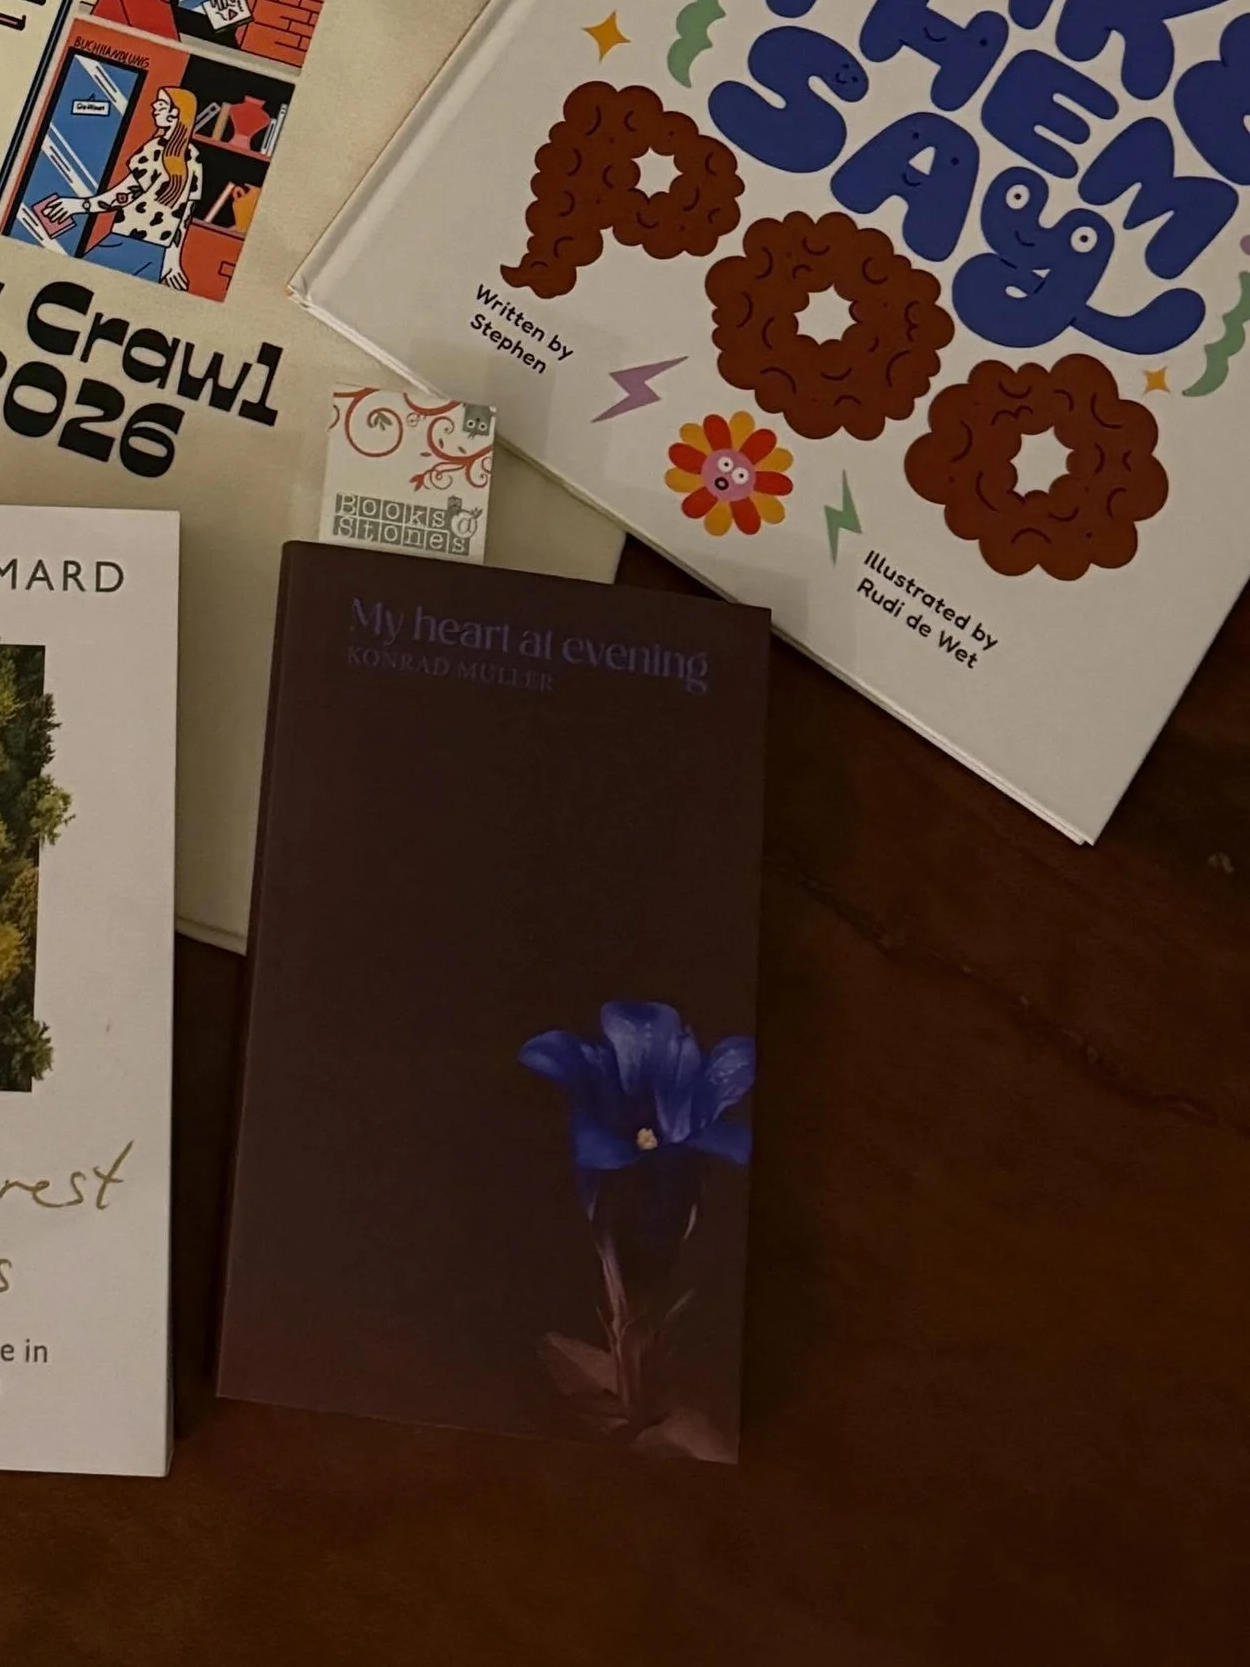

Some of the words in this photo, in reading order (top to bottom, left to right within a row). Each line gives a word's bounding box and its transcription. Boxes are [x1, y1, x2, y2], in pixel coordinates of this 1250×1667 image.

[24, 280, 285, 428] Crawl
[470, 313, 546, 374] Stephen
[476, 284, 545, 342] Written
[547, 334, 574, 361] by
[333, 514, 469, 556] Stones
[857, 577, 905, 617] Rudi
[906, 615, 932, 637] de
[938, 630, 977, 669] Wet
[864, 550, 971, 630] Illustrated
[971, 622, 998, 651] by
[346, 646, 448, 677] KONRAD
[348, 597, 403, 646] My
[412, 606, 511, 654] heart
[519, 628, 553, 660] at
[562, 633, 710, 695] evening
[24, 1339, 48, 1364] in
